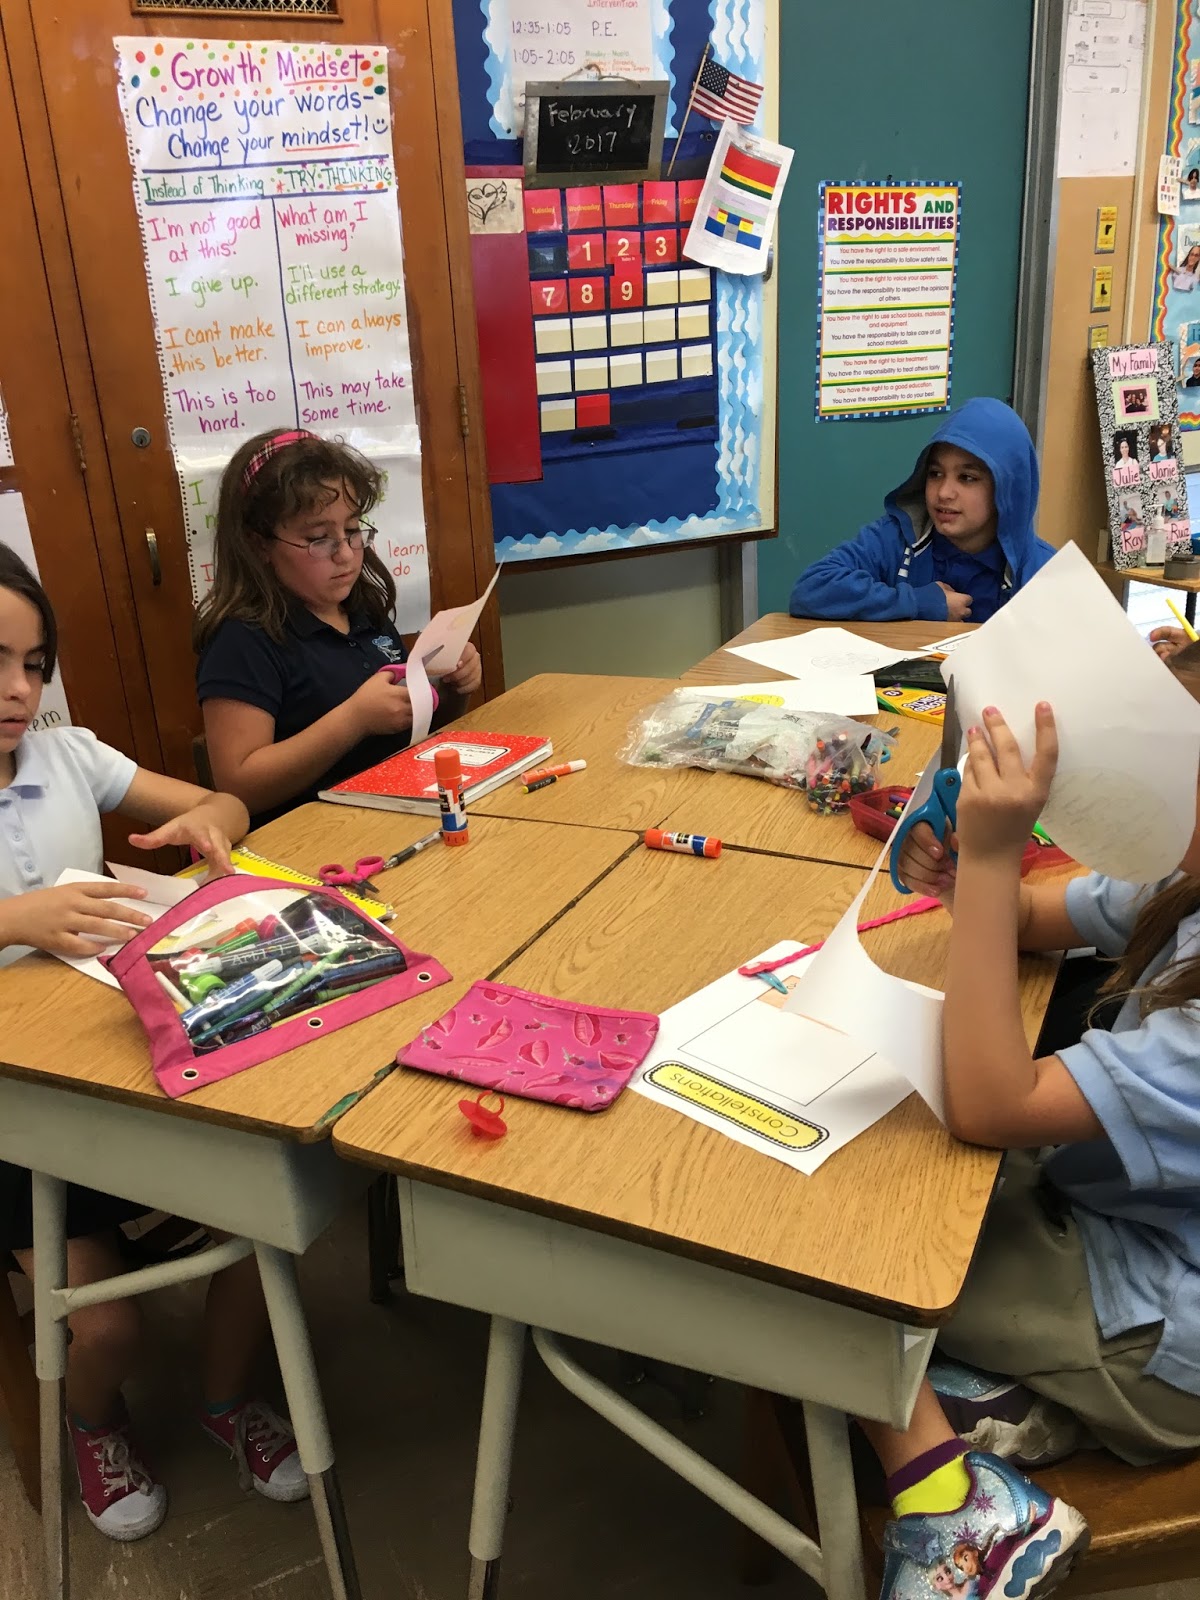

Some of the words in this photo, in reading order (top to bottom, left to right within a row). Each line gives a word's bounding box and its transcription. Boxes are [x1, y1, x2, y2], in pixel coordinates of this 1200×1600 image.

[592, 20, 617, 37] P.E.
[171, 51, 262, 90] Growth
[277, 50, 365, 81] Mindset
[136, 96, 222, 139] Change
[234, 96, 285, 134] your
[548, 101, 637, 128] February
[168, 129, 230, 168] Change
[238, 136, 274, 164] your
[282, 115, 369, 149] mindset!
[568, 131, 617, 155] 2017
[139, 177, 187, 203] Instead
[193, 177, 203, 196] of
[208, 175, 264, 199] Thinking
[284, 169, 317, 189] TRY
[320, 165, 392, 185] THINKING
[277, 203, 317, 229] What
[323, 208, 347, 225] am
[355, 201, 368, 222] I
[568, 204, 600, 212] Wednesday
[609, 202, 635, 210] Thursday
[651, 198, 668, 207] Friday
[828, 192, 917, 215] RIGHTS
[924, 201, 954, 214] AND
[147, 217, 184, 242] I'm
[190, 212, 217, 237] not
[227, 206, 261, 246] good
[828, 216, 954, 231] RESPONSIBILITIES
[296, 222, 356, 252] missing?
[582, 241, 591, 261] 1
[617, 238, 630, 257] 2
[655, 236, 667, 257] 3
[169, 243, 188, 263] at
[320, 265, 345, 279] use
[351, 265, 367, 277] a
[165, 277, 181, 297] I
[191, 276, 222, 308] give
[285, 281, 347, 304] different
[542, 287, 555, 306] 7
[581, 284, 594, 304] 8
[621, 281, 633, 301] 9
[164, 327, 184, 349] I
[230, 317, 275, 340] make
[295, 320, 311, 338] I
[316, 319, 345, 333] can
[351, 309, 401, 334] always
[172, 352, 206, 374] this
[1112, 356, 1127, 375] My
[1129, 352, 1157, 372] Family
[172, 388, 215, 413] This
[224, 390, 238, 405] is
[245, 381, 276, 404] too
[300, 381, 333, 400] This
[342, 381, 370, 399] may
[375, 370, 406, 391] take
[302, 405, 340, 423] some
[1114, 466, 1139, 486] Julie
[189, 479, 207, 506] I
[388, 540, 425, 558] learn
[1123, 531, 1144, 551] Ray
[1170, 523, 1190, 542] Ruiz
[393, 561, 411, 577] do
[669, 1071, 799, 1138] Constellations
